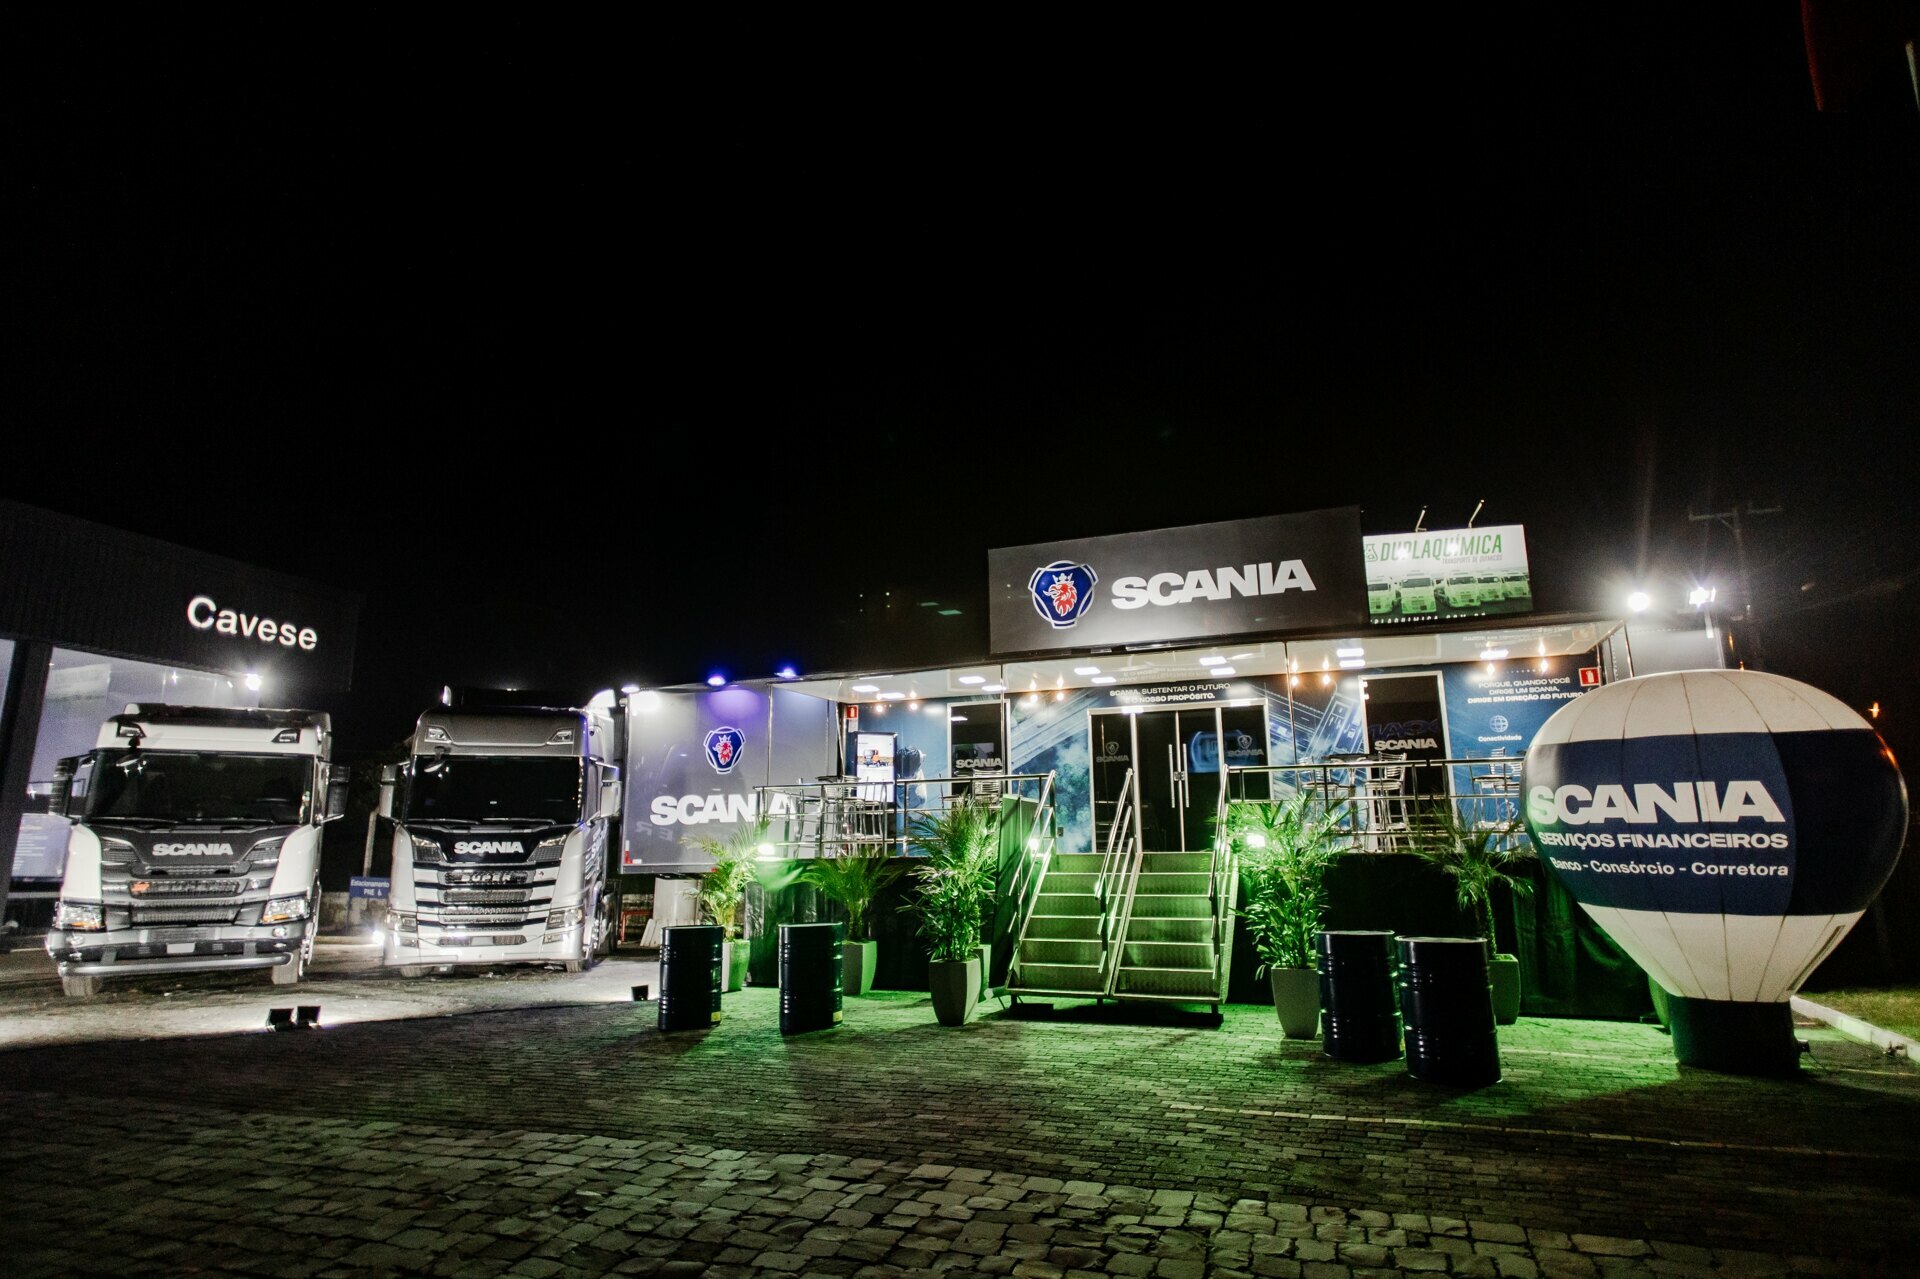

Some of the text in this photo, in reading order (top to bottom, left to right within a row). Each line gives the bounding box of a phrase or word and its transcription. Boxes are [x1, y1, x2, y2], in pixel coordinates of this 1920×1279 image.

[1111, 559, 1317, 610] SCANIA
[187, 596, 318, 650] Cavese
[1513, 679, 1548, 687] QUANDO
[1548, 677, 1571, 685] VOCÊ
[1141, 686, 1188, 695] SUSTENTAR
[1197, 683, 1231, 691] FUTURO
[1489, 688, 1515, 696] DIRIGE
[1515, 687, 1529, 695] UM
[1140, 695, 1167, 703] NOSSO
[1167, 692, 1216, 702] PROPÓSITO.
[1468, 696, 1493, 704] DIRIGE
[1493, 695, 1505, 703] EM
[1505, 693, 1538, 702] DIREÇÃO
[1478, 734, 1523, 742] Conectividade
[1374, 738, 1438, 751] SCANIA
[1227, 748, 1265, 757] SCANIA
[956, 758, 1003, 769] SCANIA
[1096, 755, 1130, 763] SCANIA
[1527, 780, 1786, 825] SCANIA
[1537, 832, 1789, 850] SERVIÇOS FINANCEIROS
[152, 843, 234, 856] SCANIA
[454, 841, 525, 854] SCANIA
[1549, 857, 1582, 872] Banco
[1590, 860, 1675, 875] Consórcio
[1691, 862, 1789, 876] Corretora
[461, 872, 512, 882] SUPER
